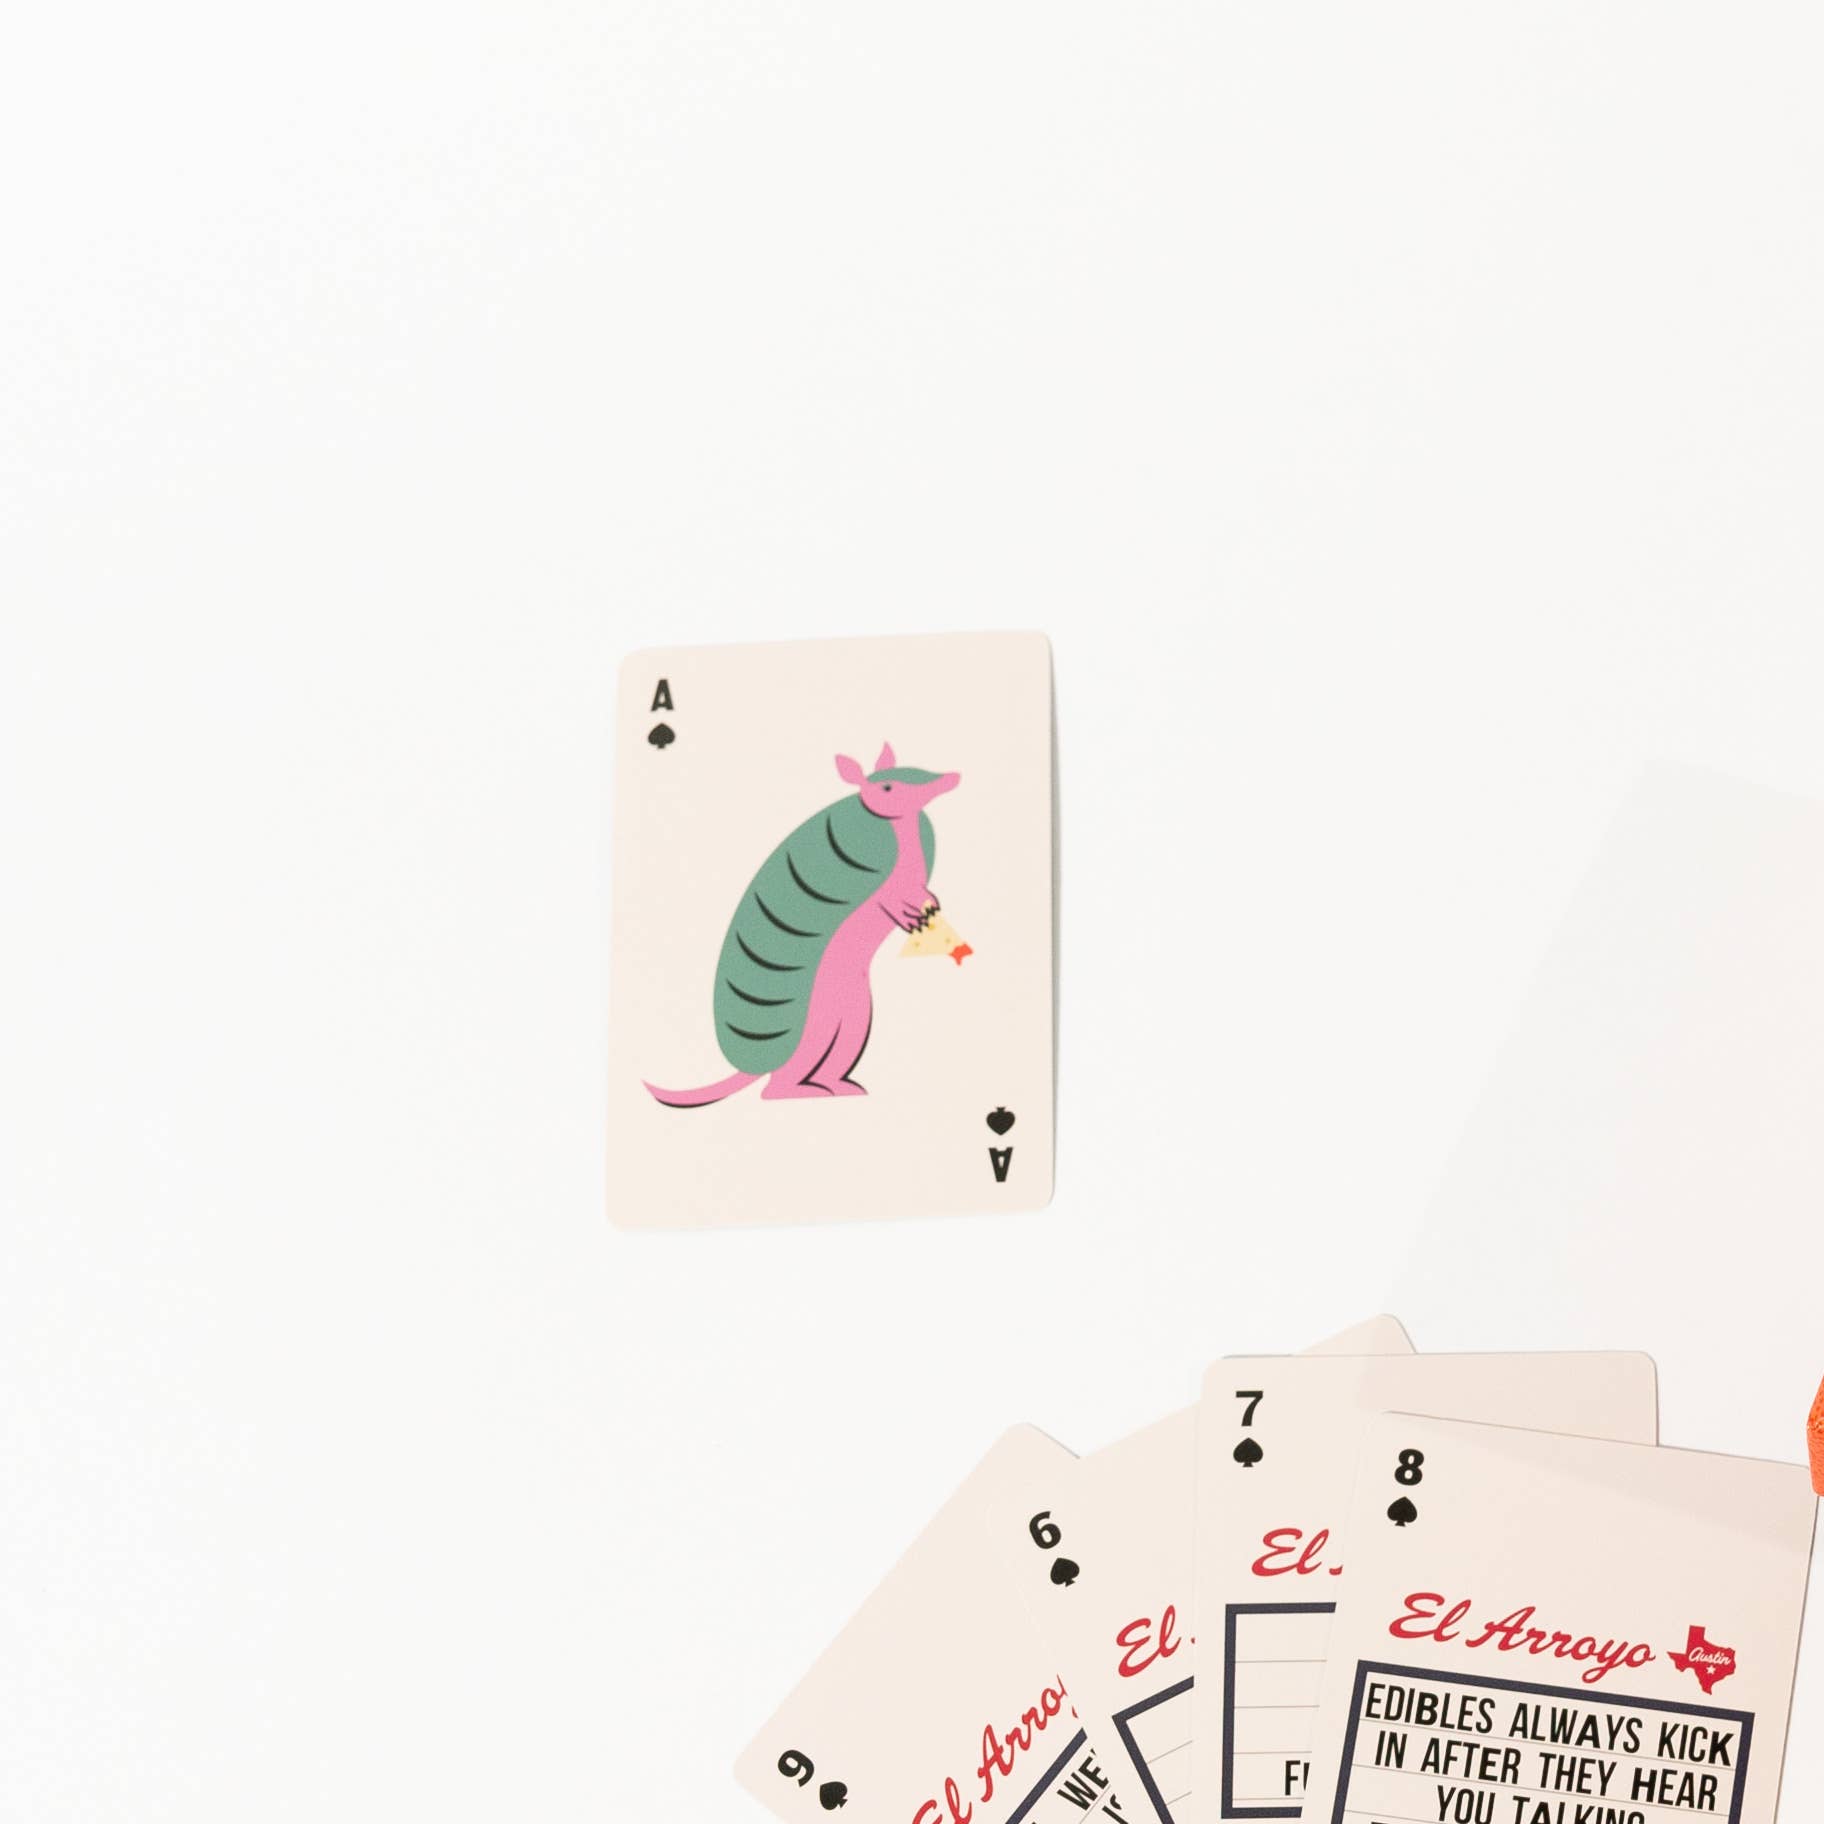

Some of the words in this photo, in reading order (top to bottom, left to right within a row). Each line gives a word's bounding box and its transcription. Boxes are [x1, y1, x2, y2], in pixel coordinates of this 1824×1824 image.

[650, 678, 675, 712] A
[988, 1146, 1014, 1183] A
[1235, 1390, 1264, 1427] 7
[1393, 1448, 1425, 1486] 8
[1028, 1511, 1062, 1550] 6
[1251, 1527, 1330, 1576] El
[1115, 1605, 1182, 1677] El
[1389, 1591, 1472, 1642] El
[1465, 1606, 1656, 1684] Arroyo
[1688, 1646, 1732, 1666] Austin
[1364, 1682, 1496, 1734] EDIBLES
[1508, 1702, 1643, 1755] ALWAYS
[1657, 1722, 1735, 1767] KICK
[776, 1748, 816, 1787] 9
[1374, 1730, 1407, 1770] IN
[1420, 1741, 1522, 1786] AFTER
[1538, 1753, 1618, 1797] THEY
[1630, 1767, 1719, 1811] HEAR
